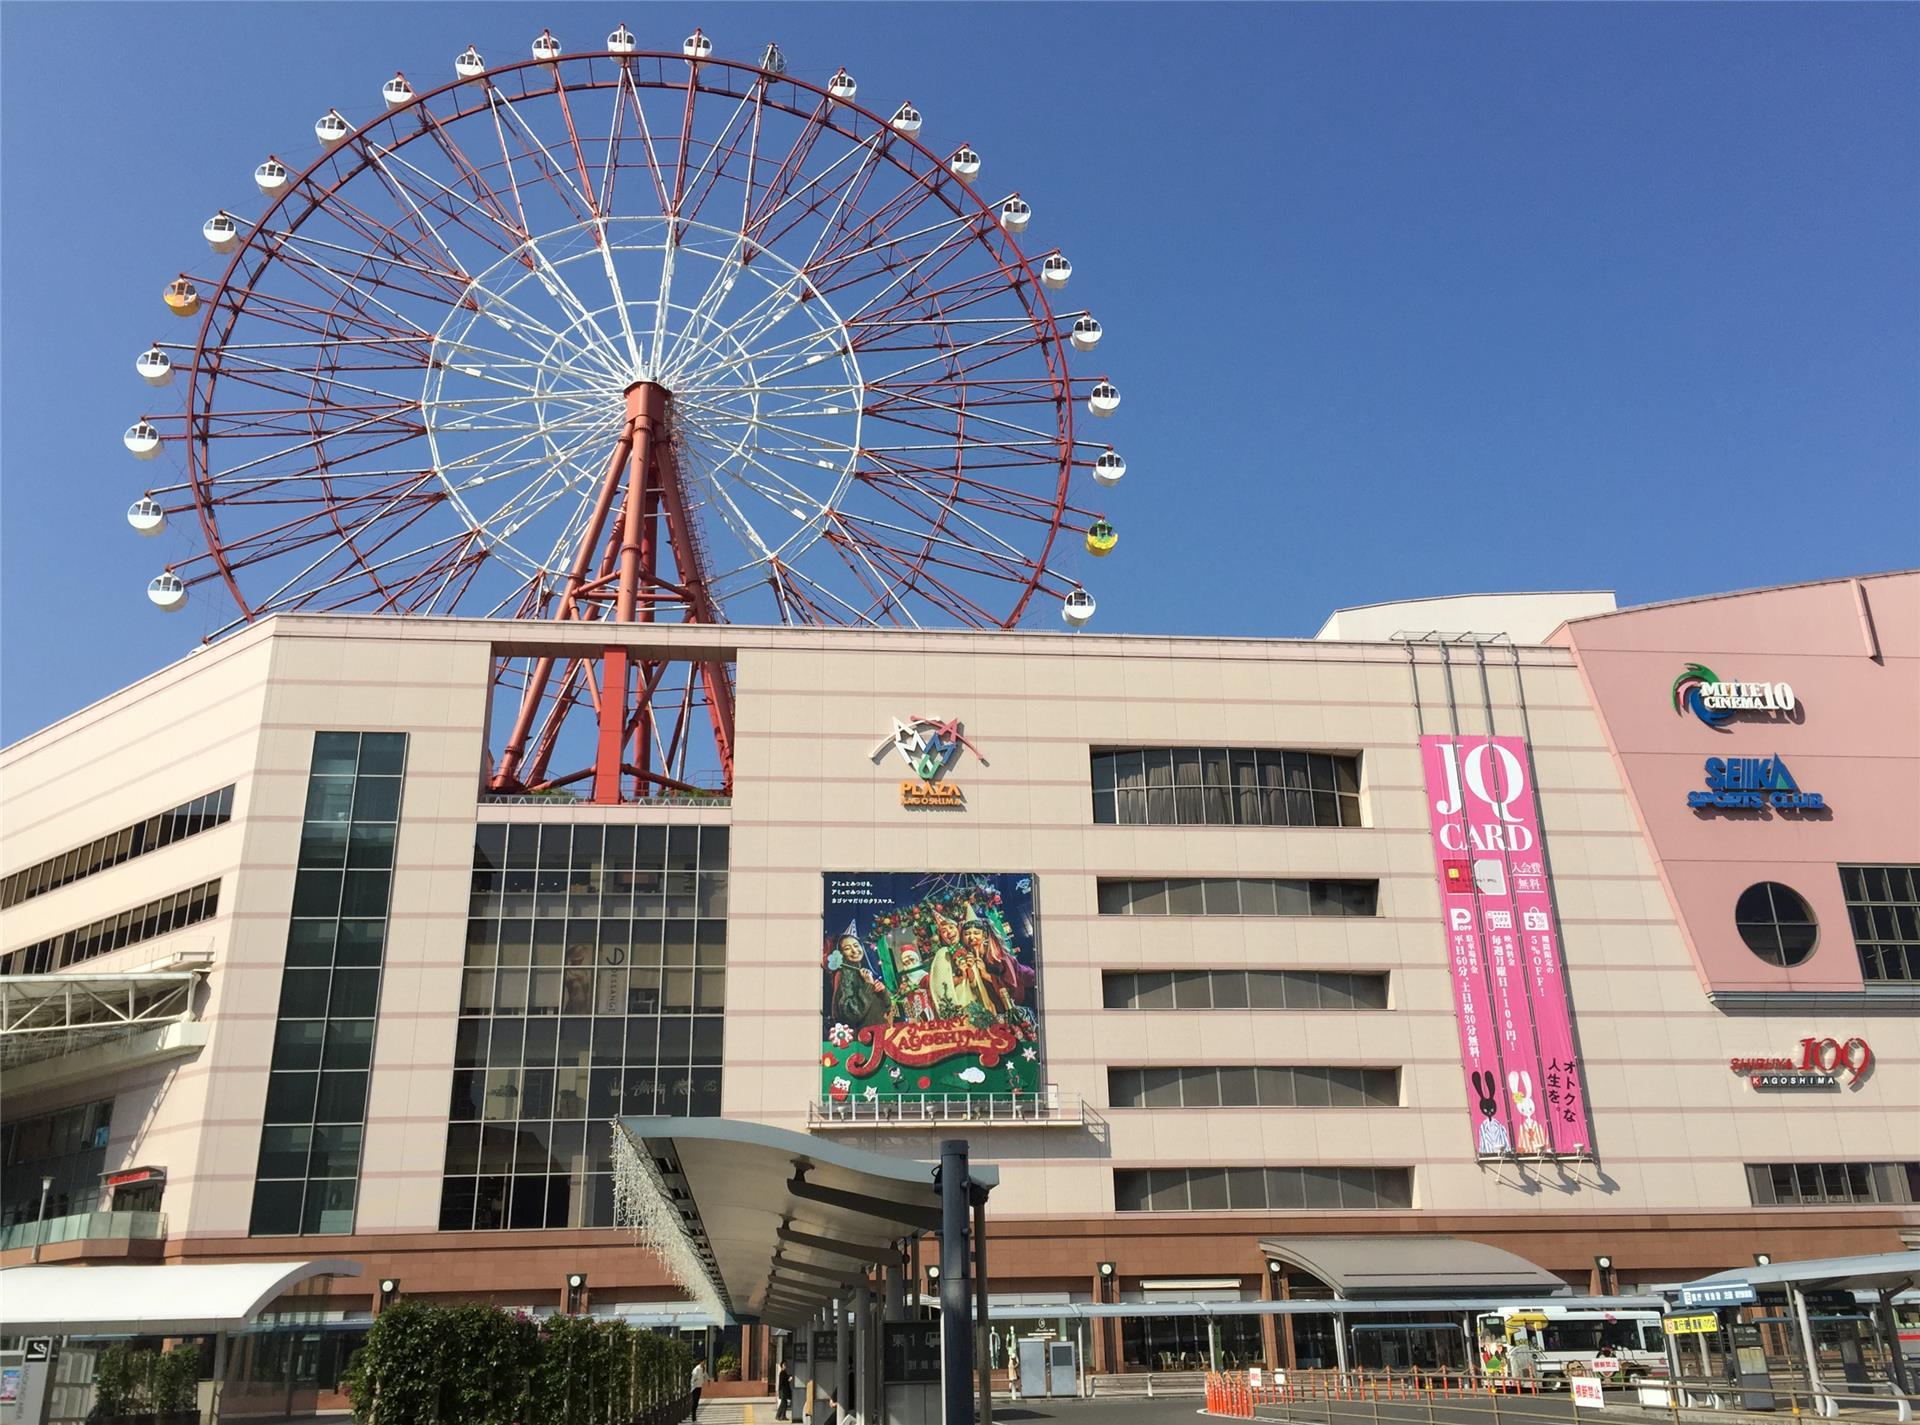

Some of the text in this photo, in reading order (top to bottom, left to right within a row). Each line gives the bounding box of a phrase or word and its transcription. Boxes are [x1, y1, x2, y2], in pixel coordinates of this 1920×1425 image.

[1700, 682, 1763, 697] MITTE
[1704, 697, 1763, 709] CINEMA
[1704, 752, 1798, 790] SEIKA
[899, 780, 961, 796] PLAZA
[1435, 743, 1524, 823] JQ
[899, 797, 961, 806] KAGOSHIMA
[1687, 791, 1825, 808] SPORTS CLUB
[1440, 823, 1533, 851] CARD
[1512, 862, 1542, 874] 入会費
[1518, 878, 1541, 890] 無料
[908, 1014, 968, 1034] MERRY
[1730, 1037, 1871, 1086] SHIBUYA 109
[1752, 1077, 1835, 1086] KAGOSHIMA
[1563, 1061, 1576, 1123] オトクな
[1575, 1384, 1602, 1400] 横断禁止
